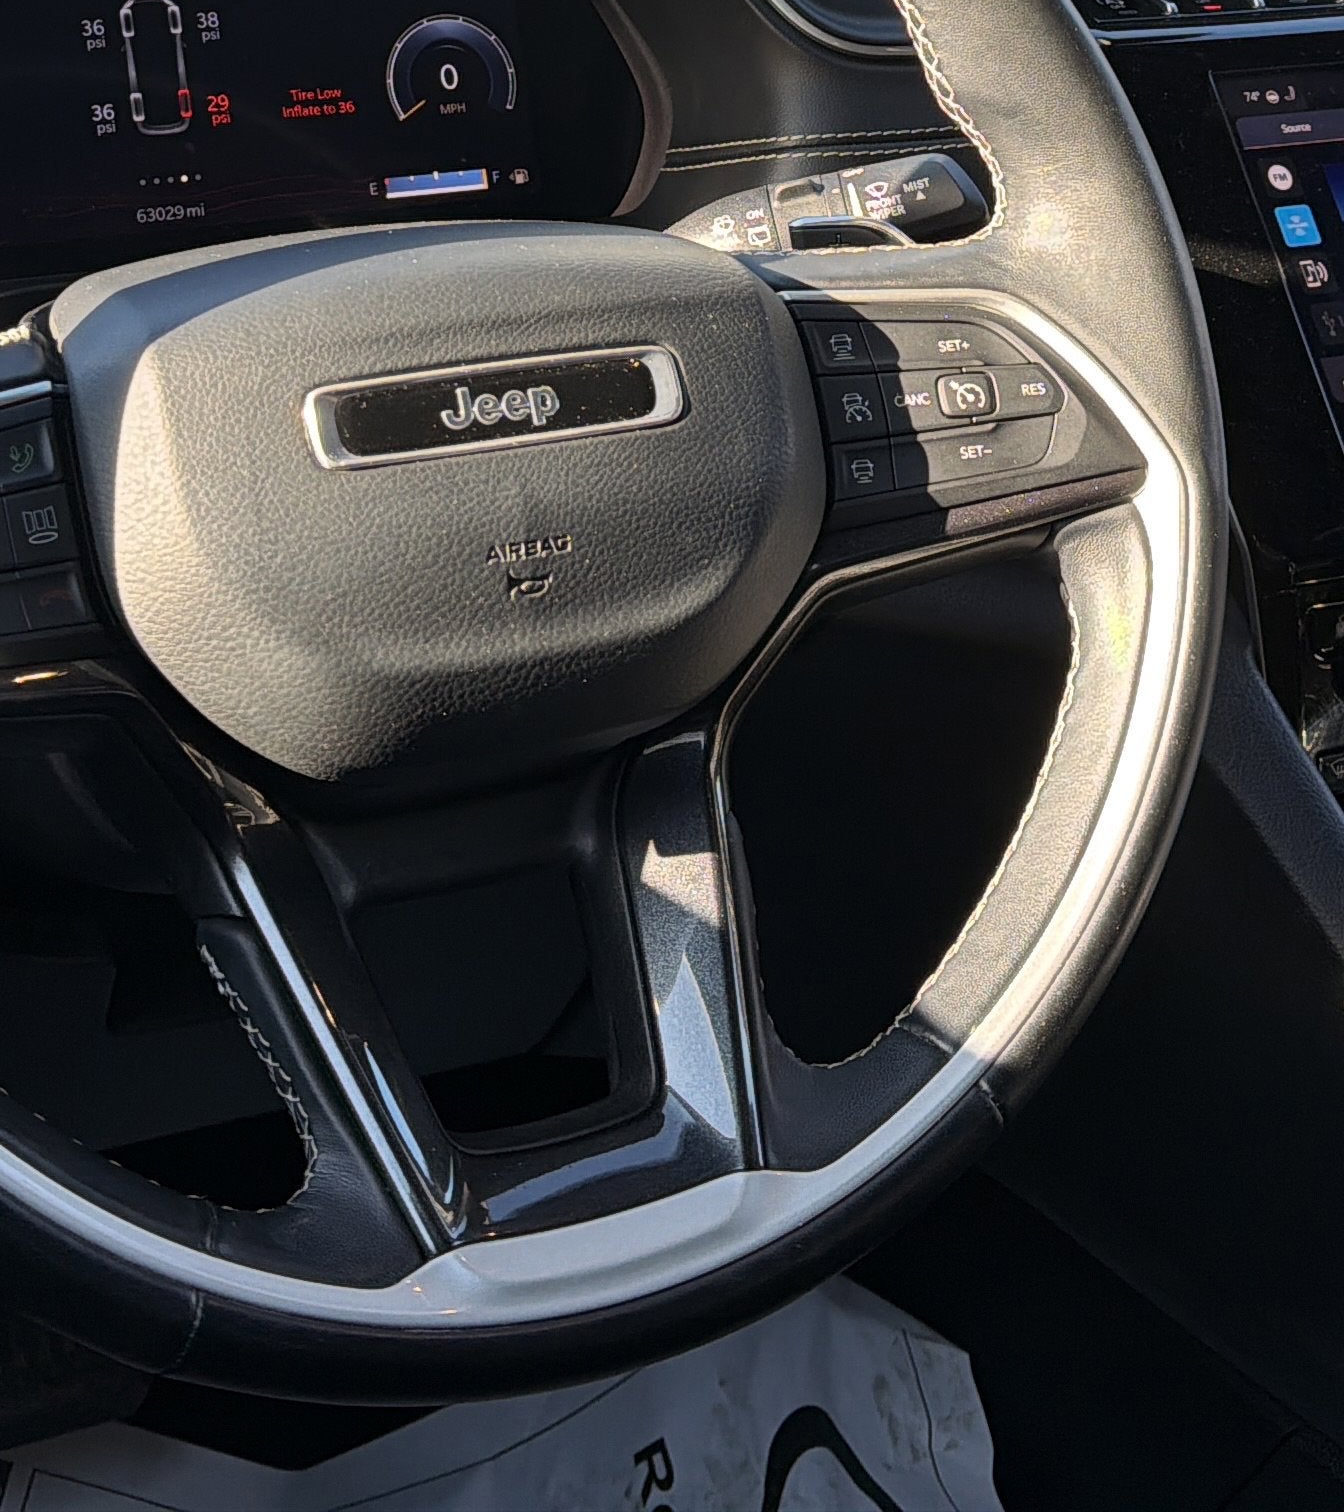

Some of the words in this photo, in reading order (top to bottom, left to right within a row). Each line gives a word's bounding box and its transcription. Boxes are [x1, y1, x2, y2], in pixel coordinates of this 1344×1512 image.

[196, 11, 219, 28] 38
[81, 19, 105, 37] 36
[201, 28, 220, 43] psi
[86, 36, 106, 51] psi
[440, 64, 458, 90] 0
[289, 89, 314, 101] Tire
[317, 88, 342, 100] Low
[207, 94, 229, 112] 29
[282, 104, 321, 118] Inflate
[323, 104, 336, 115] to
[338, 101, 356, 114] 36
[440, 102, 466, 115] MPH
[91, 103, 115, 121] 36
[211, 112, 231, 127] psi
[97, 122, 116, 136] psi
[1280, 123, 1312, 133] Source
[492, 170, 500, 183] F
[902, 176, 930, 193] MIST
[1273, 173, 1288, 182] FM
[370, 183, 378, 196] E
[136, 205, 185, 223] 63029
[187, 203, 205, 218] mi
[937, 338, 971, 354] SET+
[1020, 381, 1046, 397] RES
[440, 384, 561, 430] Jeep
[893, 391, 932, 408] CANC
[485, 533, 574, 566] AIRBAG
